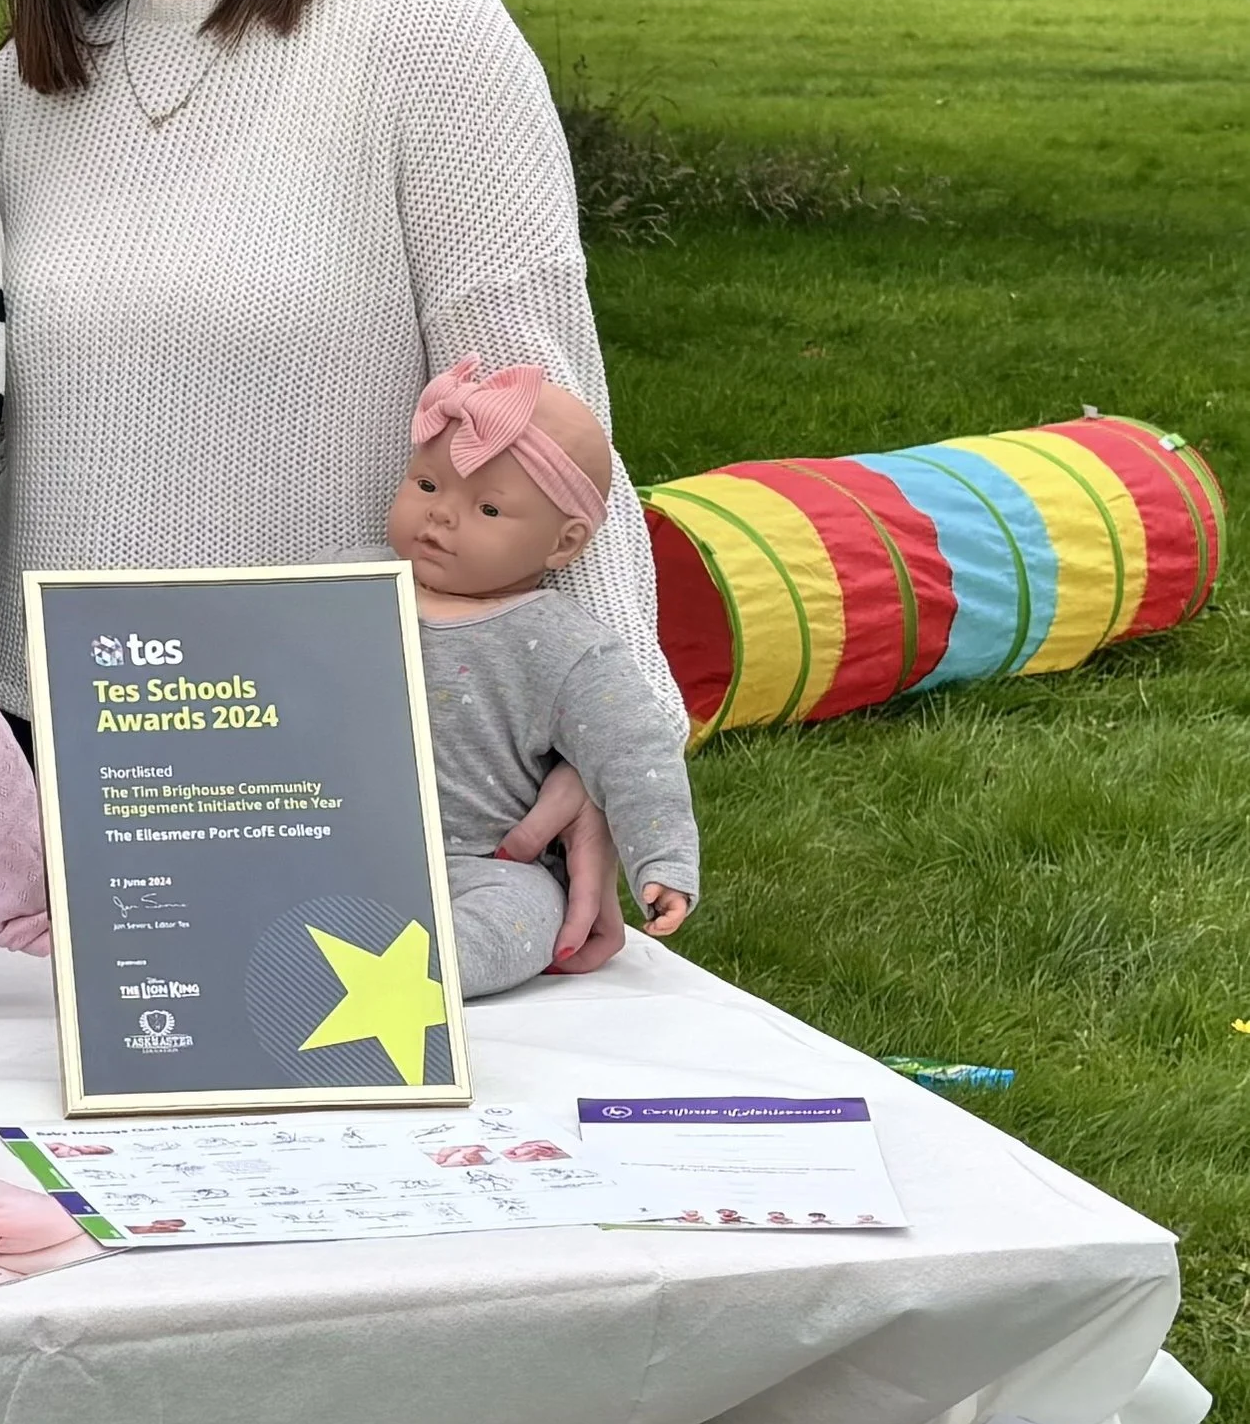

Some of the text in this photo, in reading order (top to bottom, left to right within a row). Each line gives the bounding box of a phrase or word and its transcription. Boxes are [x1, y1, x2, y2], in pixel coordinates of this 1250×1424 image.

[126, 633, 183, 666] tes
[92, 675, 257, 703] Tes Schools
[97, 704, 279, 733] Awards 2024
[100, 765, 173, 779] Shortlisted
[101, 780, 322, 800] The Tim Brighouse Community
[103, 796, 343, 818] Engagement Initiative of the Year
[105, 823, 331, 842] The Ellesmere Port CofE College
[110, 876, 172, 889] 21 June 2024
[140, 981, 169, 1000] LION
[168, 981, 200, 998] KING
